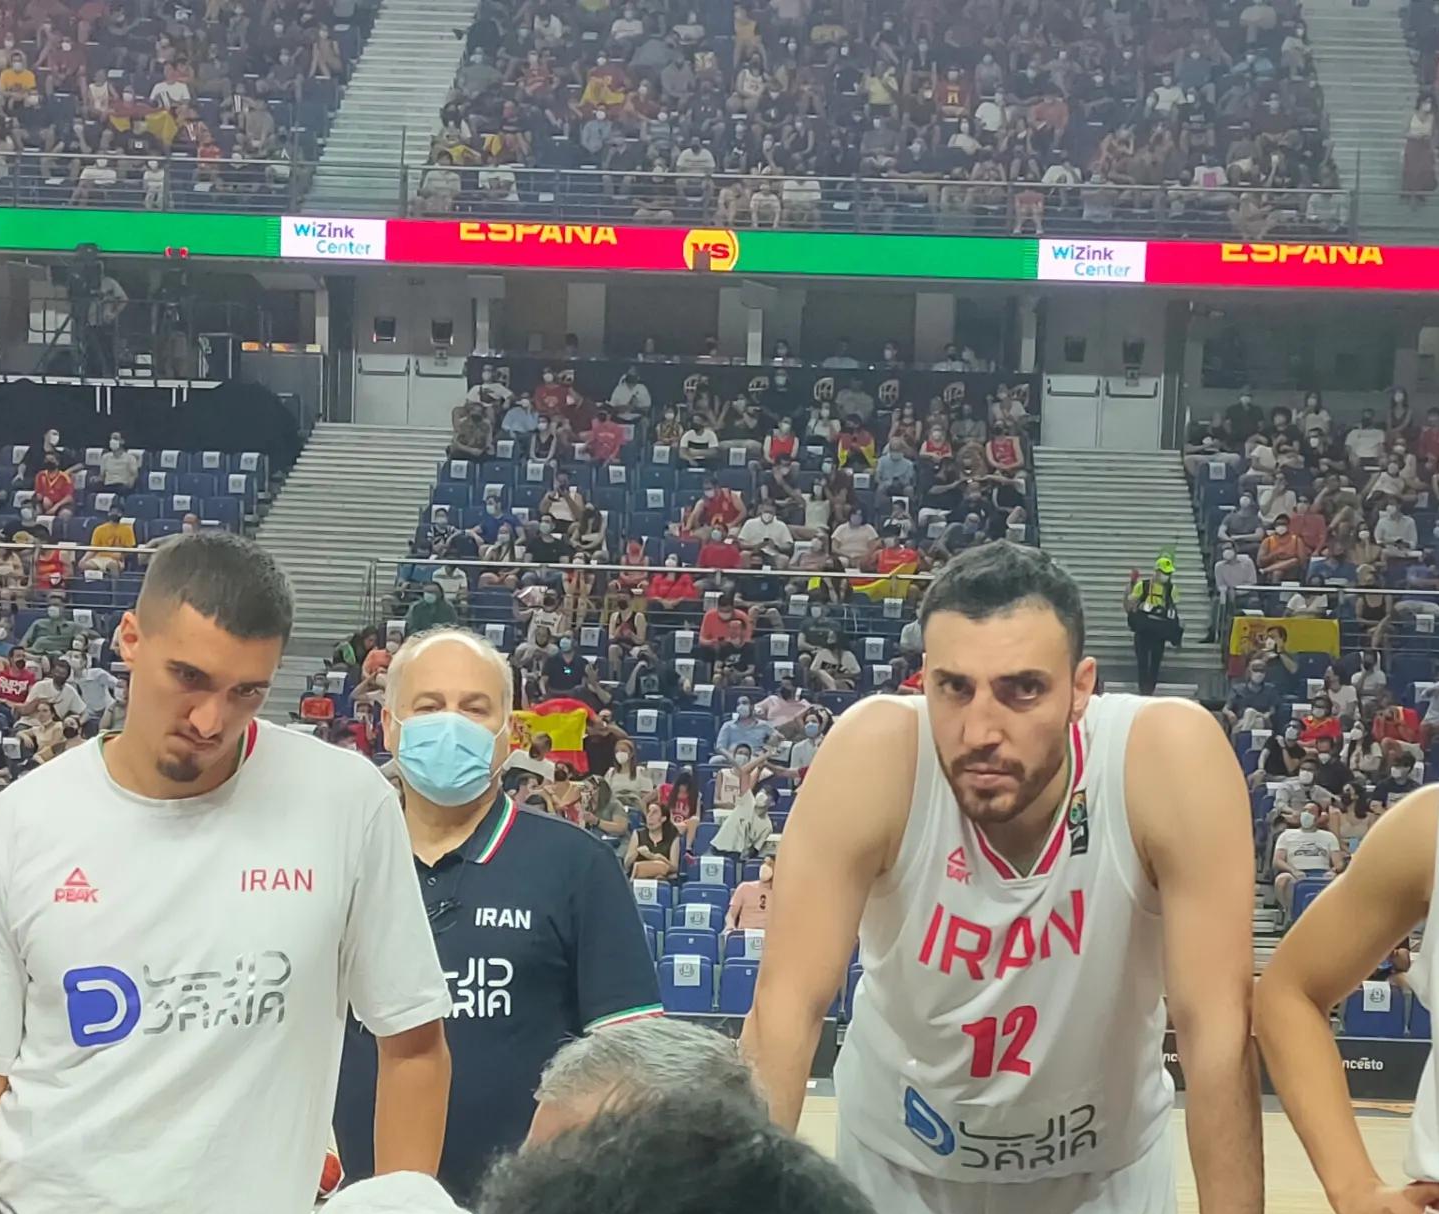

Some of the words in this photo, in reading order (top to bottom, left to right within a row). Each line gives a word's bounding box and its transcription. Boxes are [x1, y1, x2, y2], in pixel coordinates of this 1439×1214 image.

[293, 222, 355, 239] WiZink
[316, 240, 372, 256] Center
[691, 241, 730, 260] VS
[1052, 244, 1114, 261] WiZink
[1074, 261, 1130, 278] Center
[240, 867, 314, 893] IRAN
[474, 907, 532, 930] IRAN
[917, 888, 1086, 981] IRAN
[961, 1004, 1038, 1079] 12
[1342, 1056, 1385, 1072] ncesto
[960, 1129, 1097, 1171] DARIA
